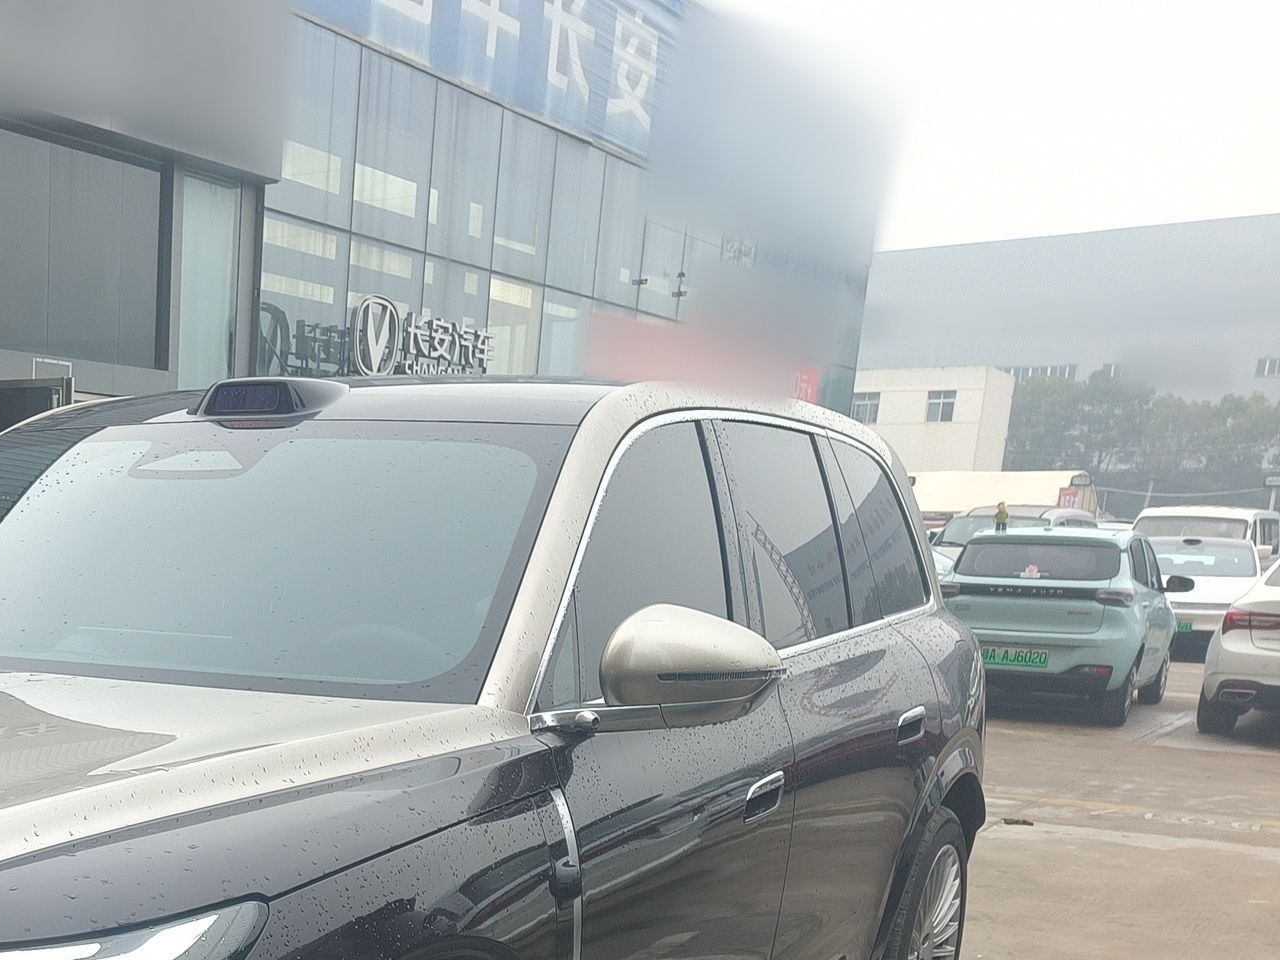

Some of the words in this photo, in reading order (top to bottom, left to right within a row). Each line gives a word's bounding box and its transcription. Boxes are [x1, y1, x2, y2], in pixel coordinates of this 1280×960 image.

[377, 0, 658, 132] 长安
[406, 312, 496, 368] 长安汽车
[1001, 649, 1048, 665] AJ6020
